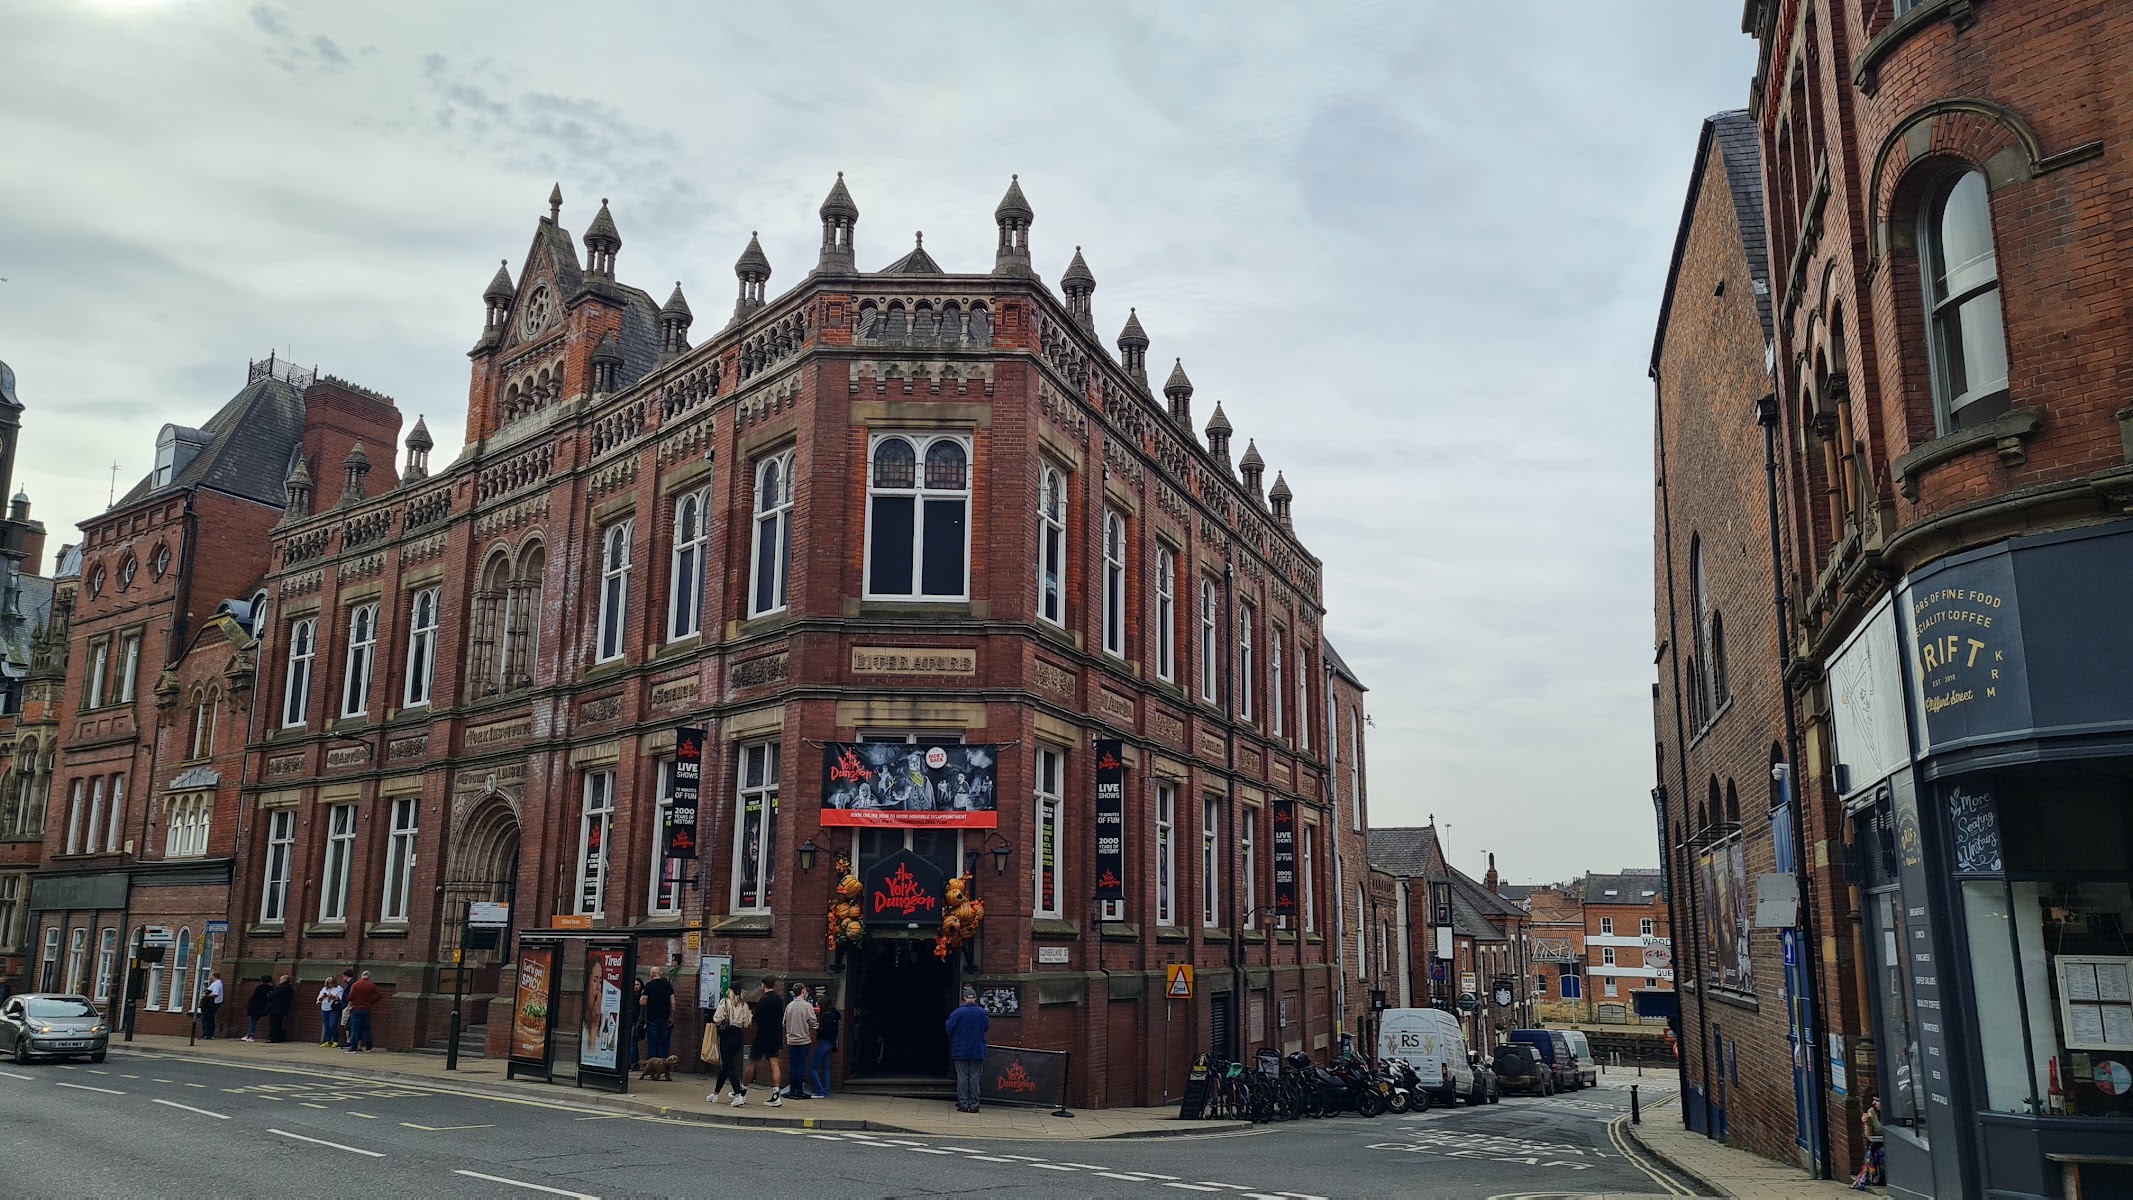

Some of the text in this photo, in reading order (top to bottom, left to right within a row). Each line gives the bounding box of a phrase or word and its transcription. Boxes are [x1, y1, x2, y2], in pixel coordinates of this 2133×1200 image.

[1914, 589, 2001, 613] ORS OF FINE FOOD
[1916, 610, 1992, 637] ECIALITY COFFEE
[1995, 650, 2003, 661] K
[1991, 668, 1999, 680] R
[1932, 679, 1941, 688] EST
[1986, 686, 1996, 698] M
[1925, 689, 1974, 713] Clifford Street
[845, 747, 858, 761] the
[677, 762, 699, 773] LIVE
[838, 757, 864, 772] York
[676, 771, 699, 780] SHOWS
[830, 765, 872, 782] Dungeon
[1098, 783, 1120, 793] LIVE
[1960, 792, 1993, 813] More
[674, 807, 695, 815] 2000
[1097, 816, 1120, 824] OF FUN
[1275, 831, 1292, 839] LIVE
[1955, 811, 1995, 845] Seating
[1098, 837, 1119, 845] 2000
[1961, 832, 1999, 863] Upstairs
[895, 862, 914, 882] the
[884, 877, 926, 897] York
[874, 891, 936, 915] Dungeon
[604, 954, 623, 967] Tired
[523, 962, 543, 978] Let's get
[1656, 969, 1673, 977] QUE
[521, 973, 542, 990] SPICY
[1401, 1034, 1420, 1048] RS
[1012, 1058, 1024, 1073] the
[1006, 1068, 1029, 1082] York
[998, 1075, 1037, 1093] Dungeon
[1365, 1142, 1595, 1170] CLEAR
